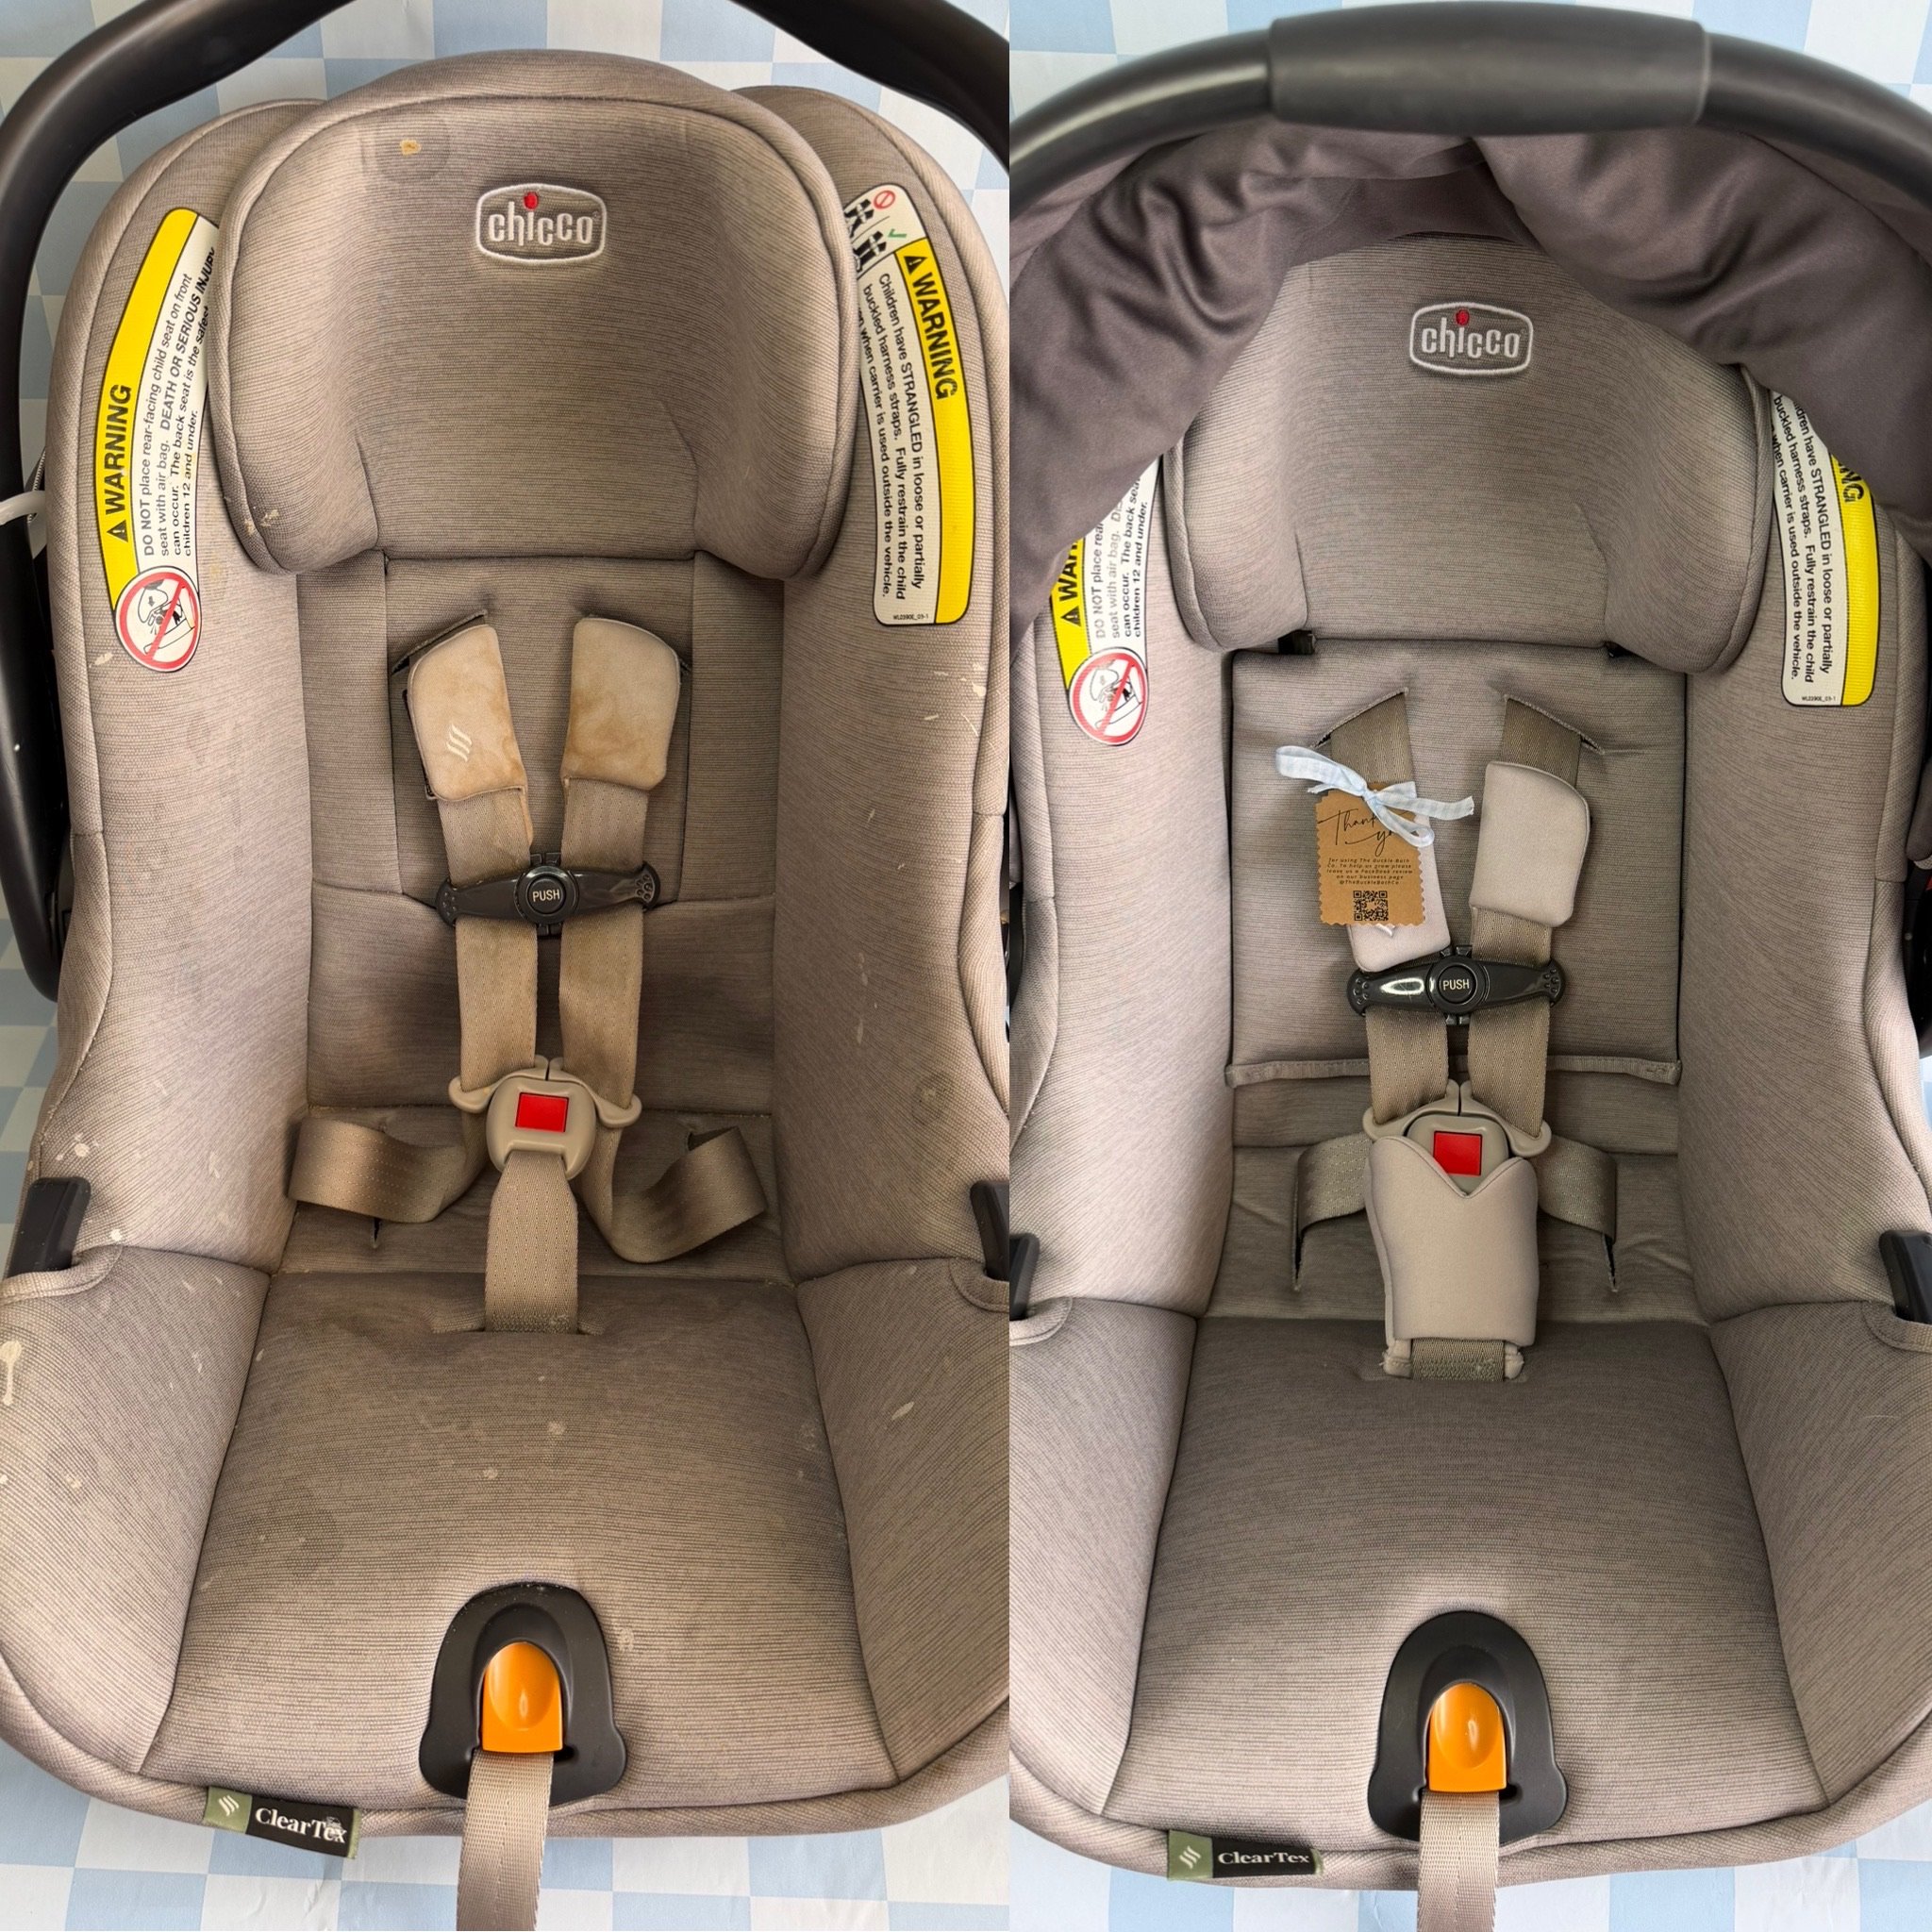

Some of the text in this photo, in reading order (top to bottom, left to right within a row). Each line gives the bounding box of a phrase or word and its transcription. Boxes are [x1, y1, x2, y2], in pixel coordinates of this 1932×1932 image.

[488, 192, 593, 246] chicco
[175, 293, 201, 354] SERIOUS
[912, 272, 958, 400] WARNING
[1421, 308, 1520, 358] chicco
[188, 346, 200, 367] the
[860, 327, 874, 364] when
[170, 356, 183, 377] OR
[184, 369, 193, 381] is
[179, 382, 191, 411] seat
[869, 366, 883, 409] carrier
[140, 274, 192, 556] DO NOT place rear-facing child seat on front
[160, 380, 177, 431] DEATH
[876, 411, 886, 425] is
[173, 415, 185, 448] back
[187, 410, 198, 450] under.
[863, 283, 908, 600] buckled harness straps. Fully restrain the child
[878, 427, 891, 462] used
[879, 273, 925, 589] Children have STRANGLED in loose or partially
[105, 384, 131, 514] WARNING
[157, 440, 170, 469] bag.
[170, 452, 181, 476] The
[1804, 435, 1817, 467] have
[156, 472, 166, 491] air
[184, 453, 192, 479] and
[182, 482, 191, 498] 12
[882, 465, 892, 517] outside
[1779, 469, 1793, 509] carrier
[156, 494, 166, 524] with
[1123, 507, 1135, 538] back
[1787, 511, 1796, 524] is
[1810, 468, 1831, 550] STRANGLED
[158, 527, 169, 556] seat
[885, 521, 893, 542] the
[1108, 530, 1121, 558] bag.
[1132, 569, 1141, 583] 12
[1137, 502, 1147, 540] under.
[1774, 394, 1818, 683] buckled harness straps. Fully restrain the child
[1788, 525, 1800, 558] used
[1091, 549, 1104, 583] place
[1107, 560, 1117, 578] air
[1121, 541, 1131, 565] The
[1822, 553, 1833, 566] in
[882, 546, 892, 597] vehicle.
[1791, 560, 1803, 608] outside
[1823, 568, 1833, 604] loose
[1091, 586, 1103, 614] NOT
[1107, 581, 1117, 608] with
[1122, 573, 1130, 611] occur.
[1094, 619, 1106, 638] DO
[1108, 611, 1120, 639] seat
[1793, 610, 1803, 631] the
[1824, 607, 1832, 620] or
[1791, 634, 1802, 680] vehicle.
[1820, 624, 1833, 674] partially
[532, 889, 560, 903] PUSH
[1442, 978, 1470, 991] PUSH
[255, 1807, 348, 1843] ClearTex
[1218, 1851, 1310, 1864] ClearTex
